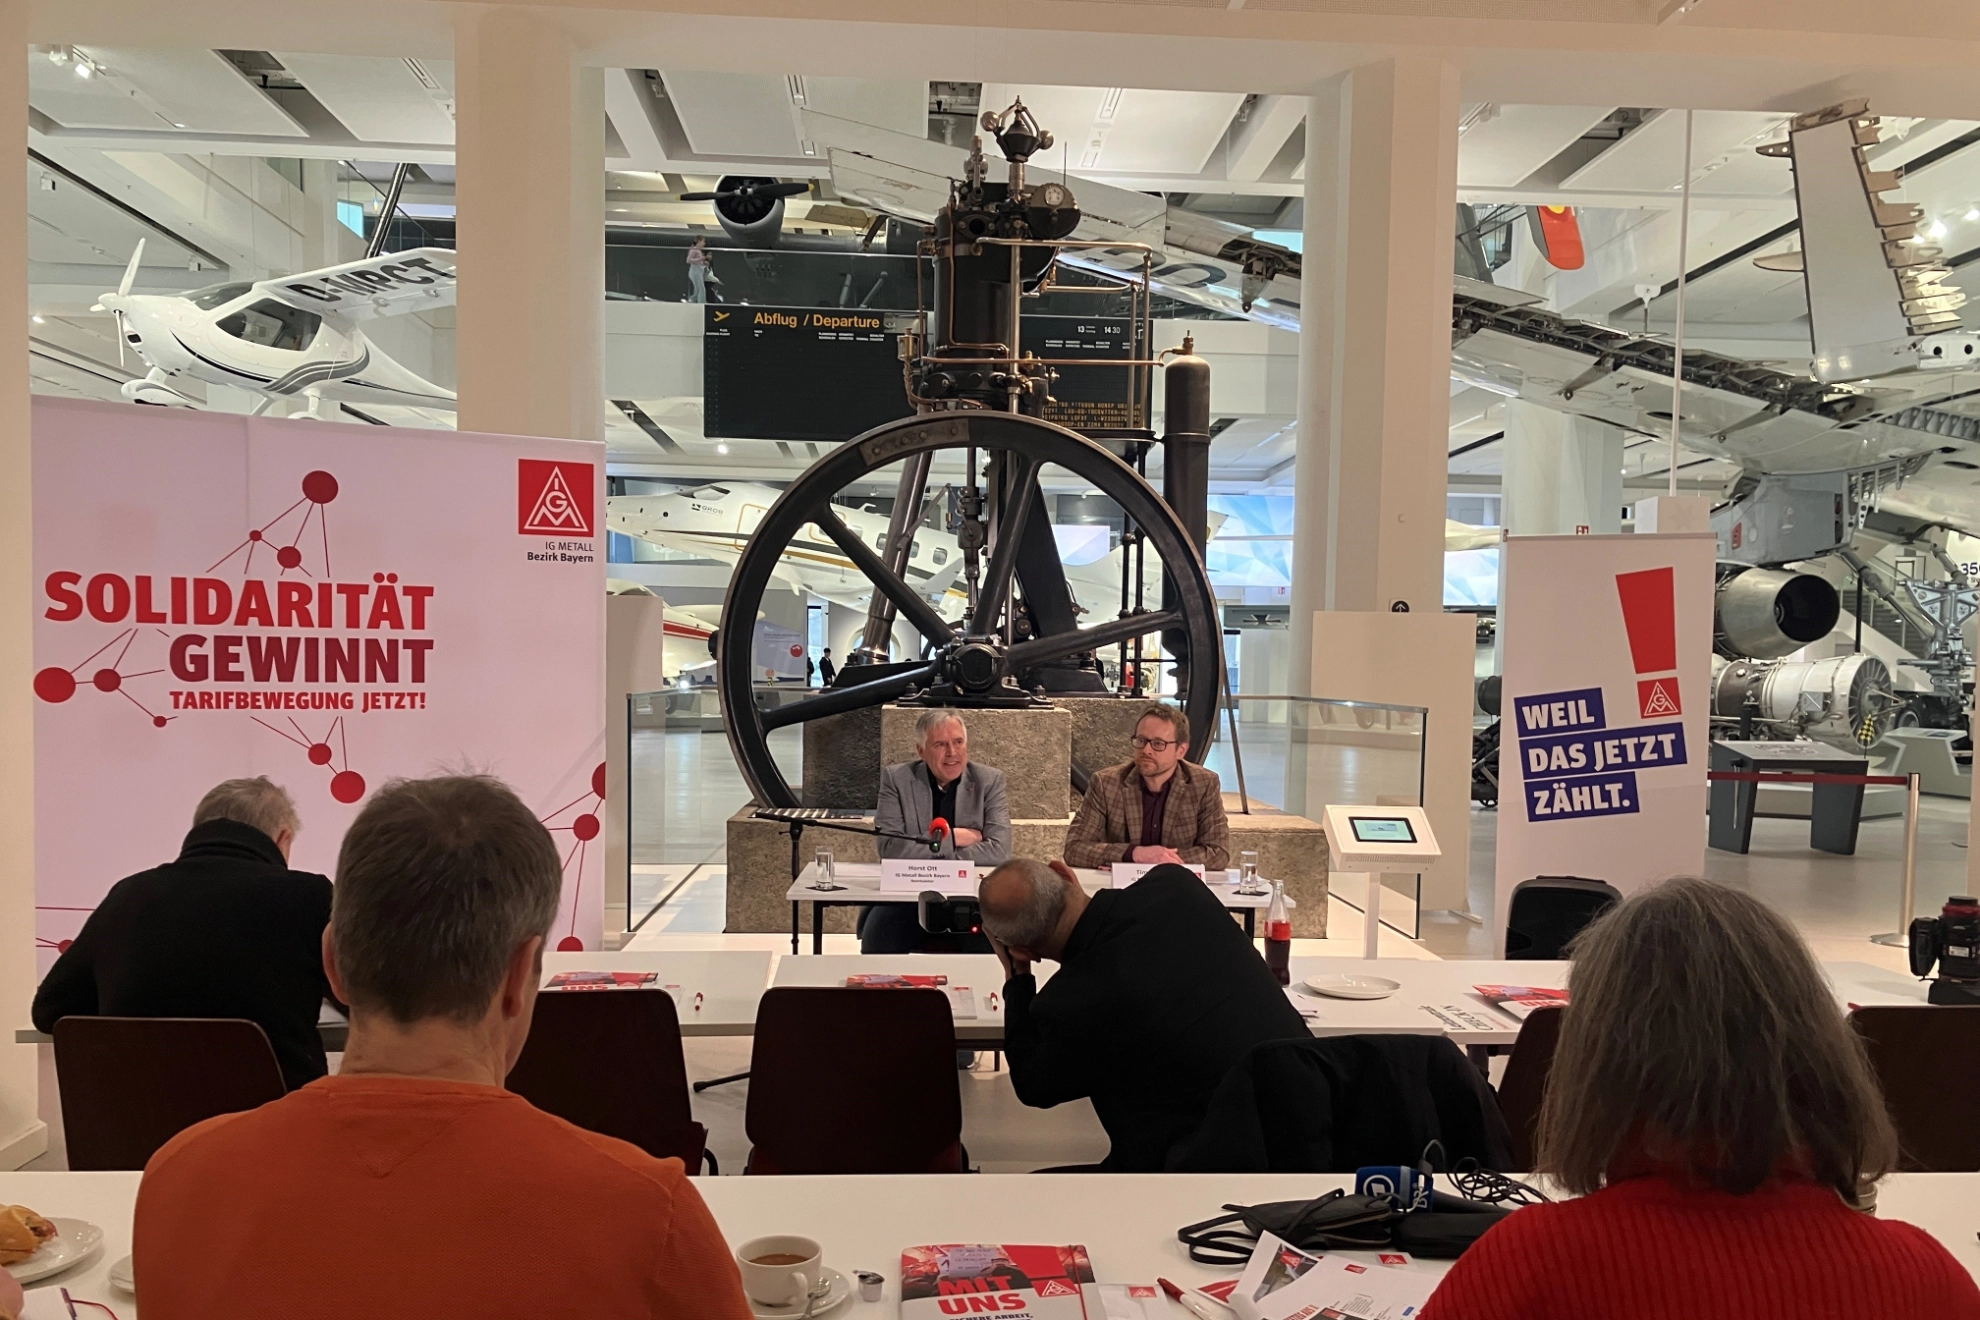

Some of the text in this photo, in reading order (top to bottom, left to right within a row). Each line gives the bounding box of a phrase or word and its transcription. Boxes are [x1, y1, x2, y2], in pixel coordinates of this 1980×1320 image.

[754, 312, 797, 328] Abflug
[813, 314, 880, 329] Departure
[545, 541, 594, 551] IG METALL
[527, 552, 593, 564] Bezirk Bayern
[1961, 562, 1980, 575] 35
[44, 571, 434, 630] SOLIDARITÄT
[169, 633, 434, 683] GEWINNT
[170, 691, 427, 713] TARIFBEWEGUNG JETZT!
[1522, 699, 1595, 730] WEIL
[1528, 733, 1676, 773] DAS JETZT
[1533, 782, 1631, 815] ZÄHLT.
[938, 1276, 1011, 1296] MIT
[938, 1293, 1026, 1314] UNS
